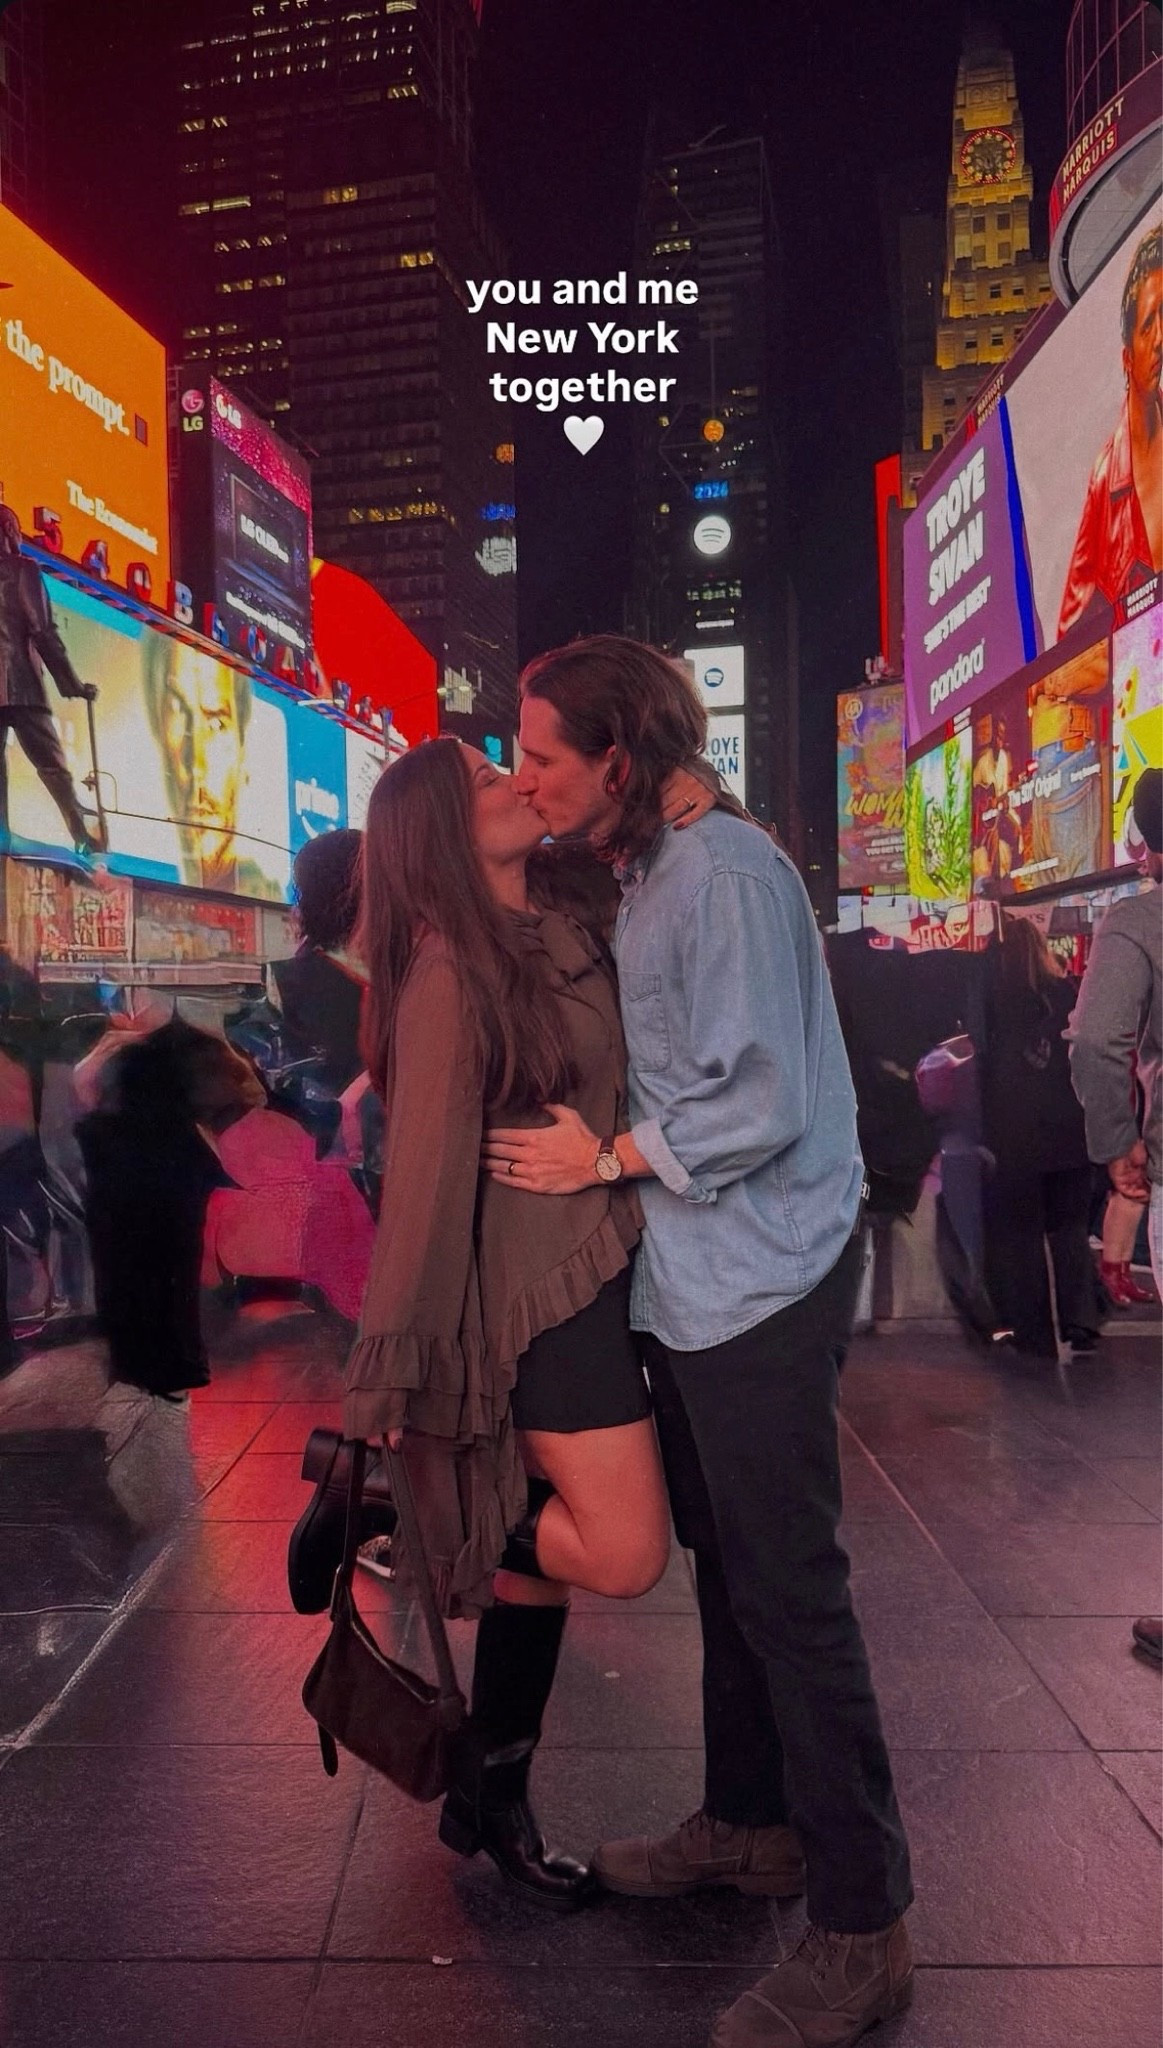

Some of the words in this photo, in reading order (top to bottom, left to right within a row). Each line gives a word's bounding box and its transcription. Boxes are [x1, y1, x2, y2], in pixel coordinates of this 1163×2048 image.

[1062, 97, 1125, 182] MARRIOTT
[1063, 130, 1116, 204] MARQUIS
[5, 319, 45, 372] the
[48, 355, 130, 436] prompt.
[182, 415, 204, 432] LG
[926, 446, 986, 553] TROYE
[928, 510, 984, 606] SIVAN
[930, 637, 986, 715] pandora
[705, 736, 740, 756] OYE
